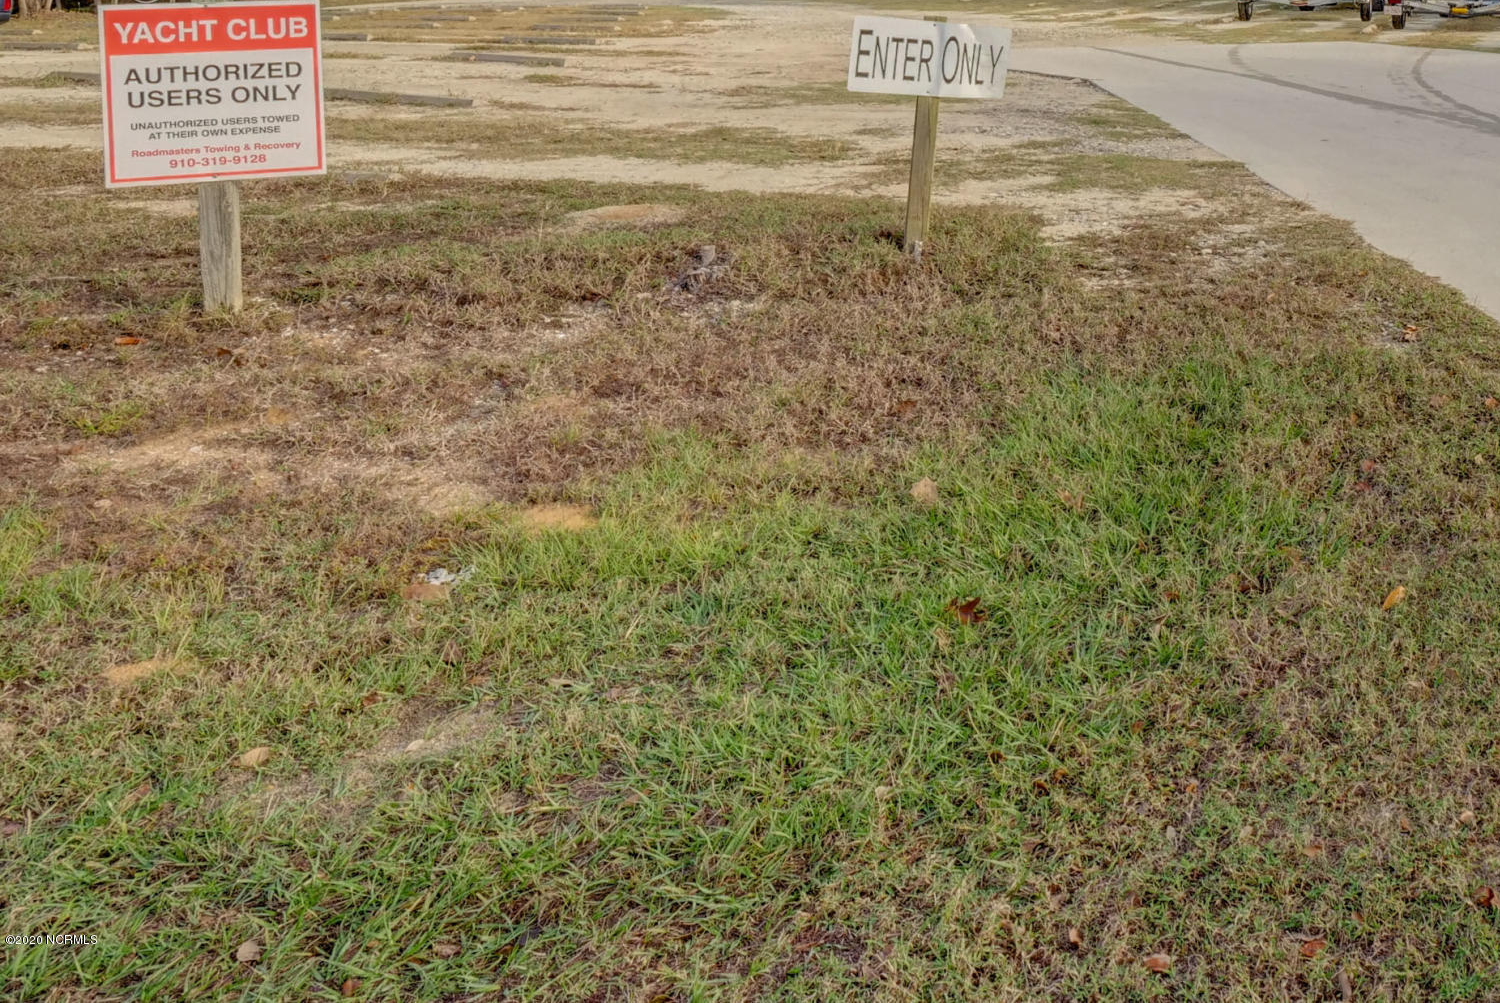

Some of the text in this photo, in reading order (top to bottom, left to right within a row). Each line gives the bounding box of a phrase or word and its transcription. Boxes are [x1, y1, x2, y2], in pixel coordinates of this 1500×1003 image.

[113, 17, 308, 44] YACHT CLUB
[854, 29, 1004, 85] ENTER ONLY
[124, 61, 302, 85] AUTHORIZED
[127, 84, 302, 109] USERS ONLY
[130, 114, 300, 131] UNAUTHORIZED USERS TOWED
[148, 125, 280, 140] AT THEIR OWN EXPENSE
[131, 141, 301, 157] Roadmasters Towing & Recovery
[169, 154, 267, 169] 910-319-9128
